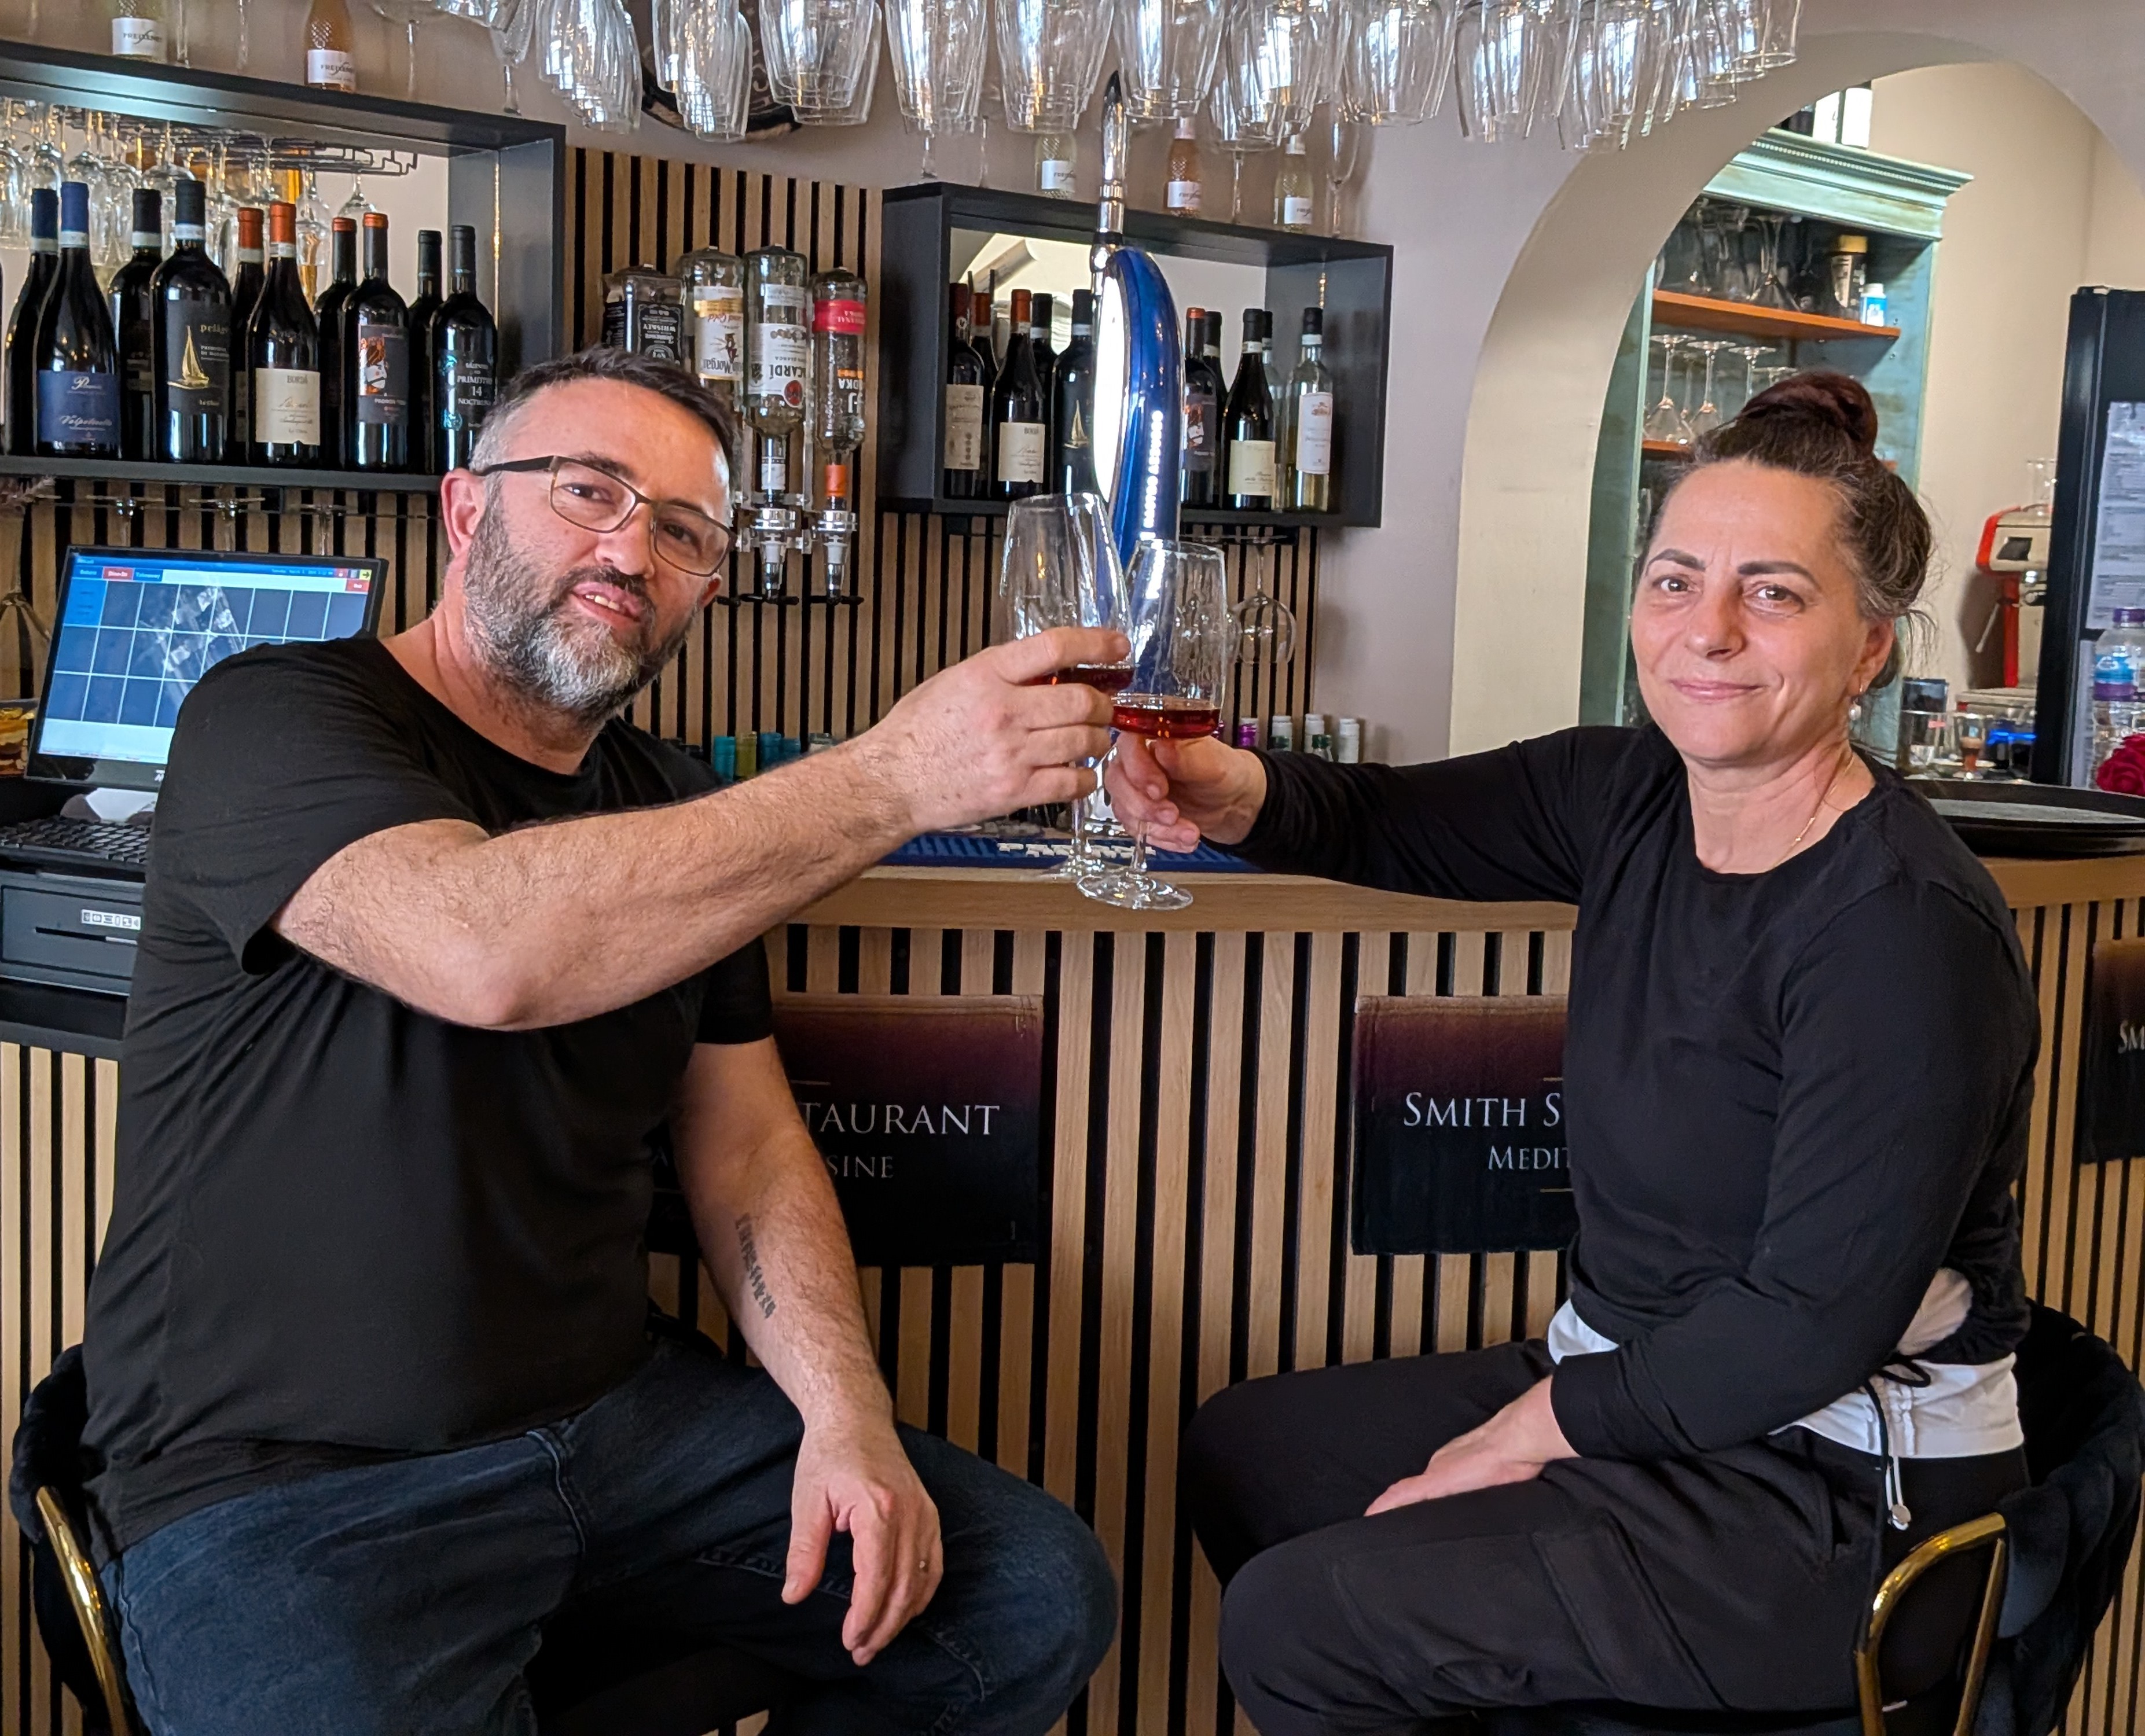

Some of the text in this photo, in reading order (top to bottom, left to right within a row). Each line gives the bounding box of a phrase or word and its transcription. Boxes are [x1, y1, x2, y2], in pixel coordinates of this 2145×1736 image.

[642, 323, 676, 332] WHISKEY
[472, 386, 482, 397] 14
[1404, 1091, 1526, 1127] SMITH
